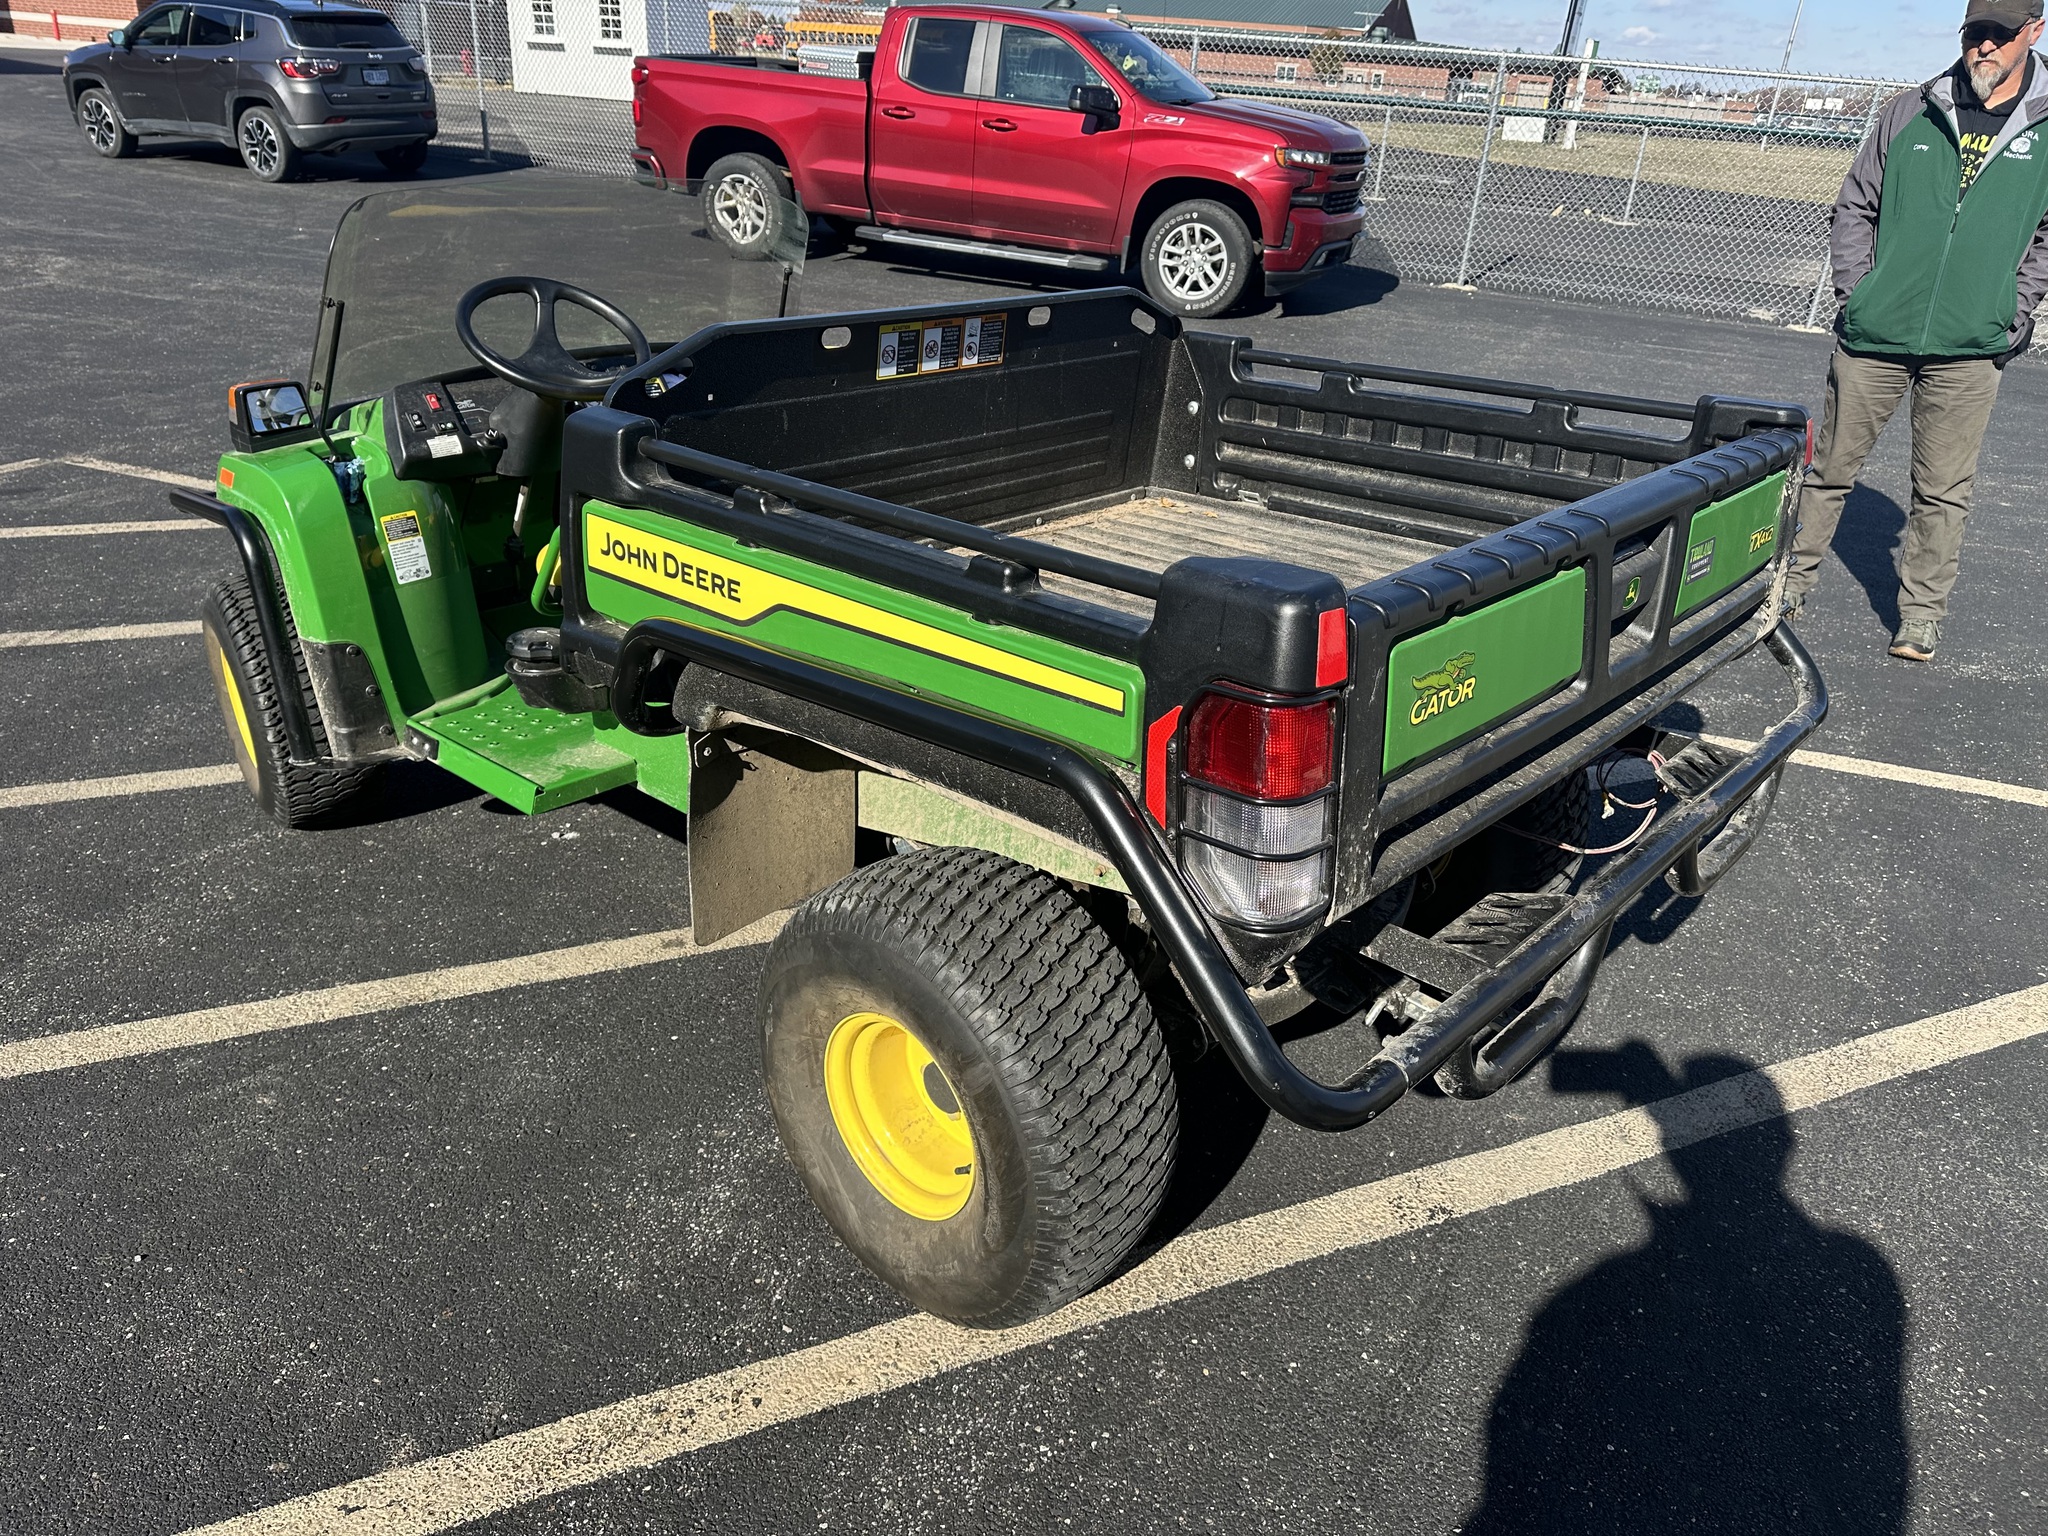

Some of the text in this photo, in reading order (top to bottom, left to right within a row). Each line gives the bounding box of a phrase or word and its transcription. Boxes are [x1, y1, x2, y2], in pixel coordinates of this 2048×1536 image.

[1143, 113, 1186, 126] Z71
[2002, 150, 2033, 160] Mechanic
[600, 532, 741, 603] JOHN DEERE
[1410, 676, 1476, 725] GATOR
